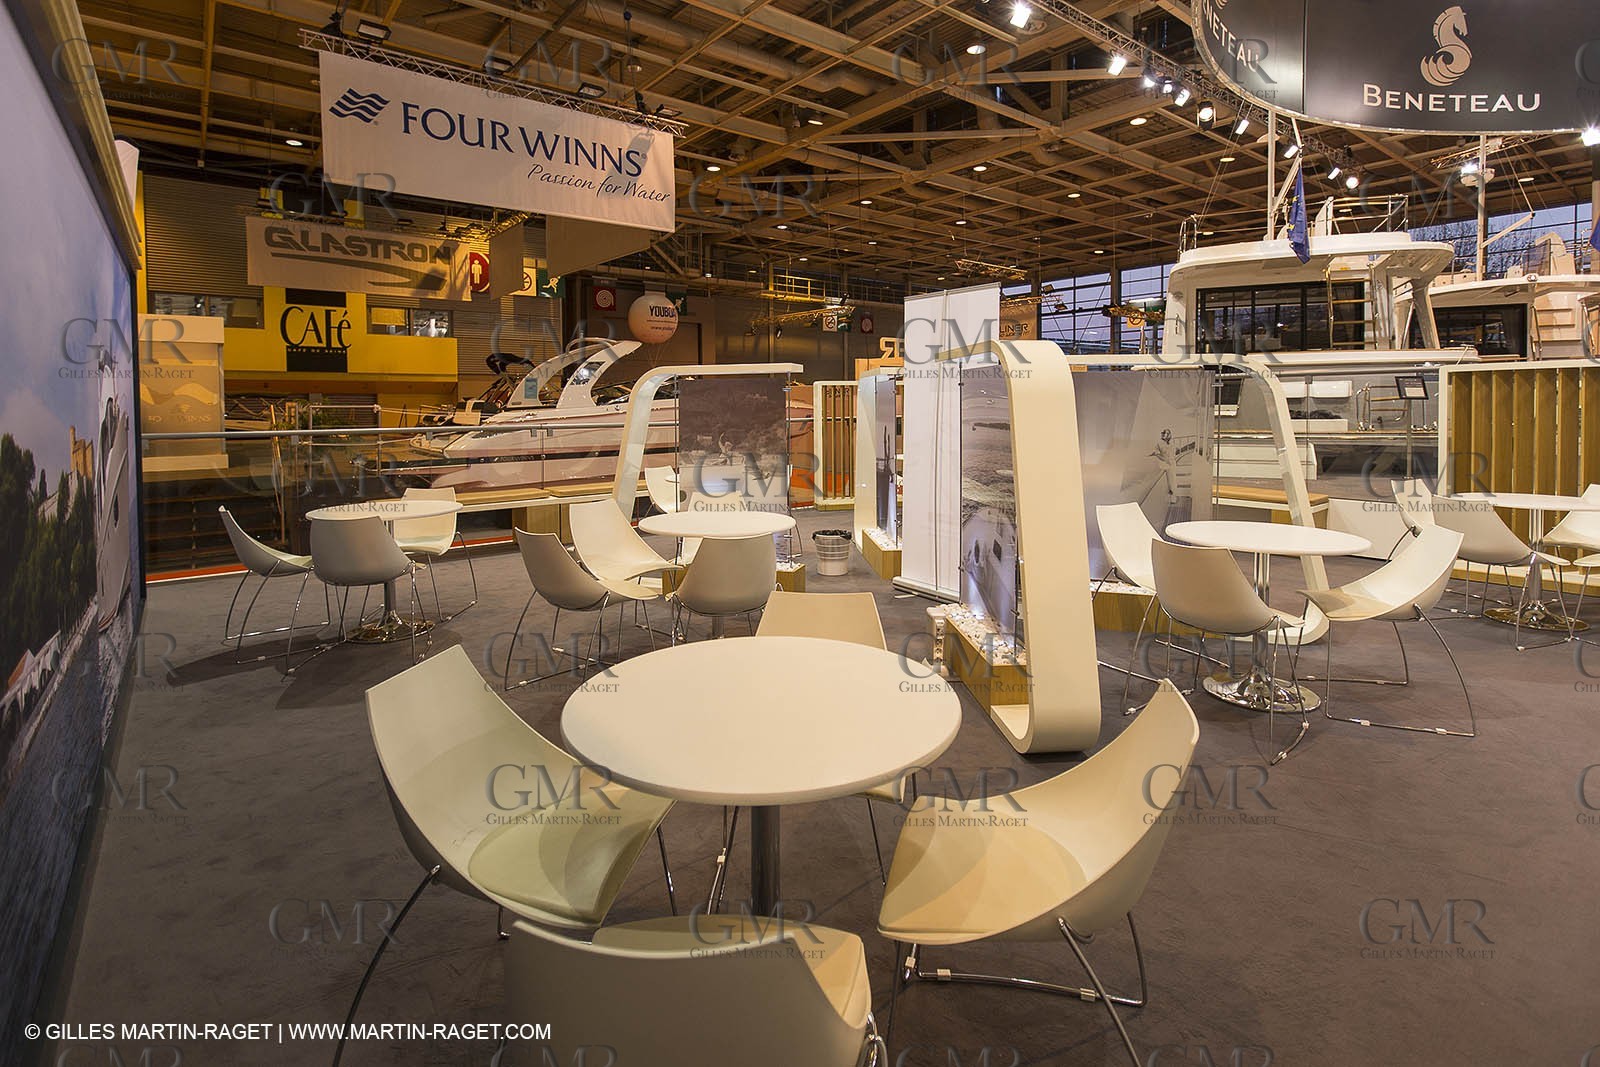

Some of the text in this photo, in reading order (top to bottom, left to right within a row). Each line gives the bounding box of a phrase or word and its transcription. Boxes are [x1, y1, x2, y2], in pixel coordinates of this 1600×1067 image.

[1362, 82, 1542, 113] BENETEAU
[401, 101, 643, 178] FOUR WINNS
[526, 162, 671, 204] Passion for Water
[264, 225, 453, 266] GLASTRON
